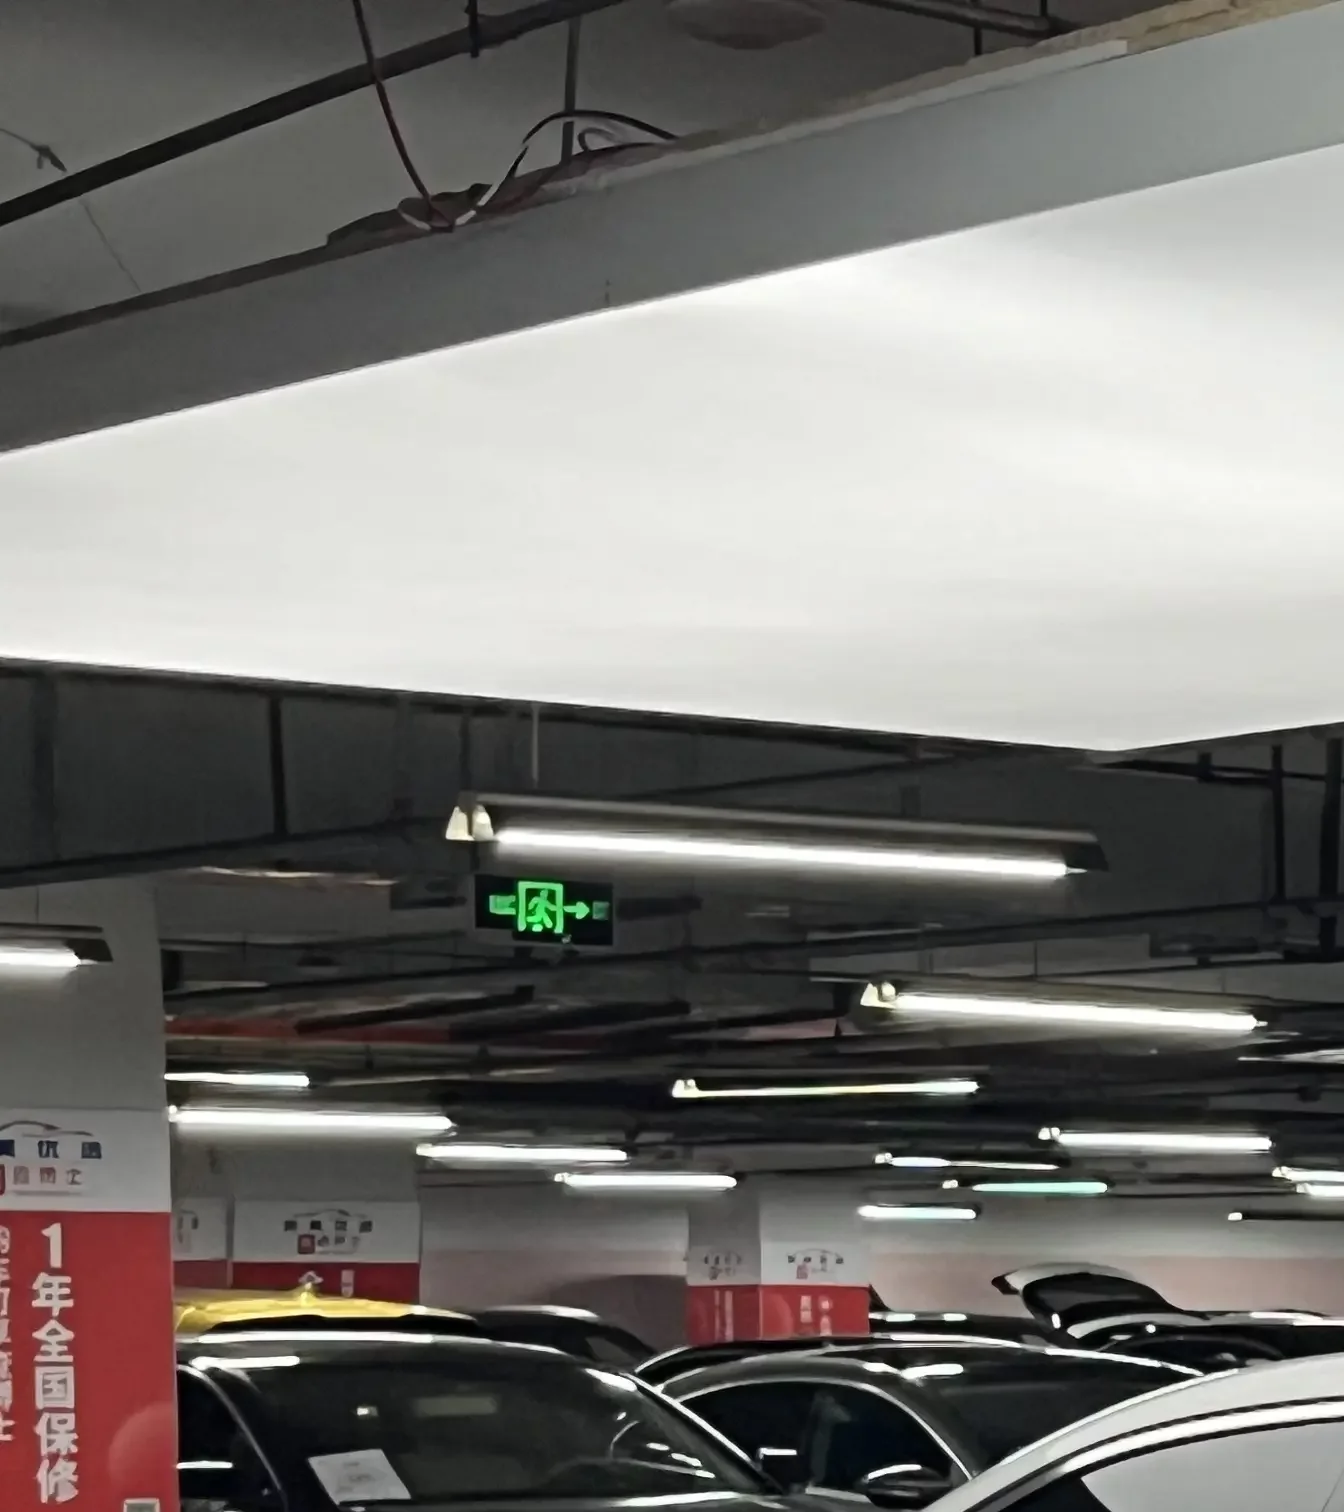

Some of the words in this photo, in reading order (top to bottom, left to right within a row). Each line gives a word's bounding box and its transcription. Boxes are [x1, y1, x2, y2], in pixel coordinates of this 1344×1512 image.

[31, 1222, 79, 1504] 1年全国保修
